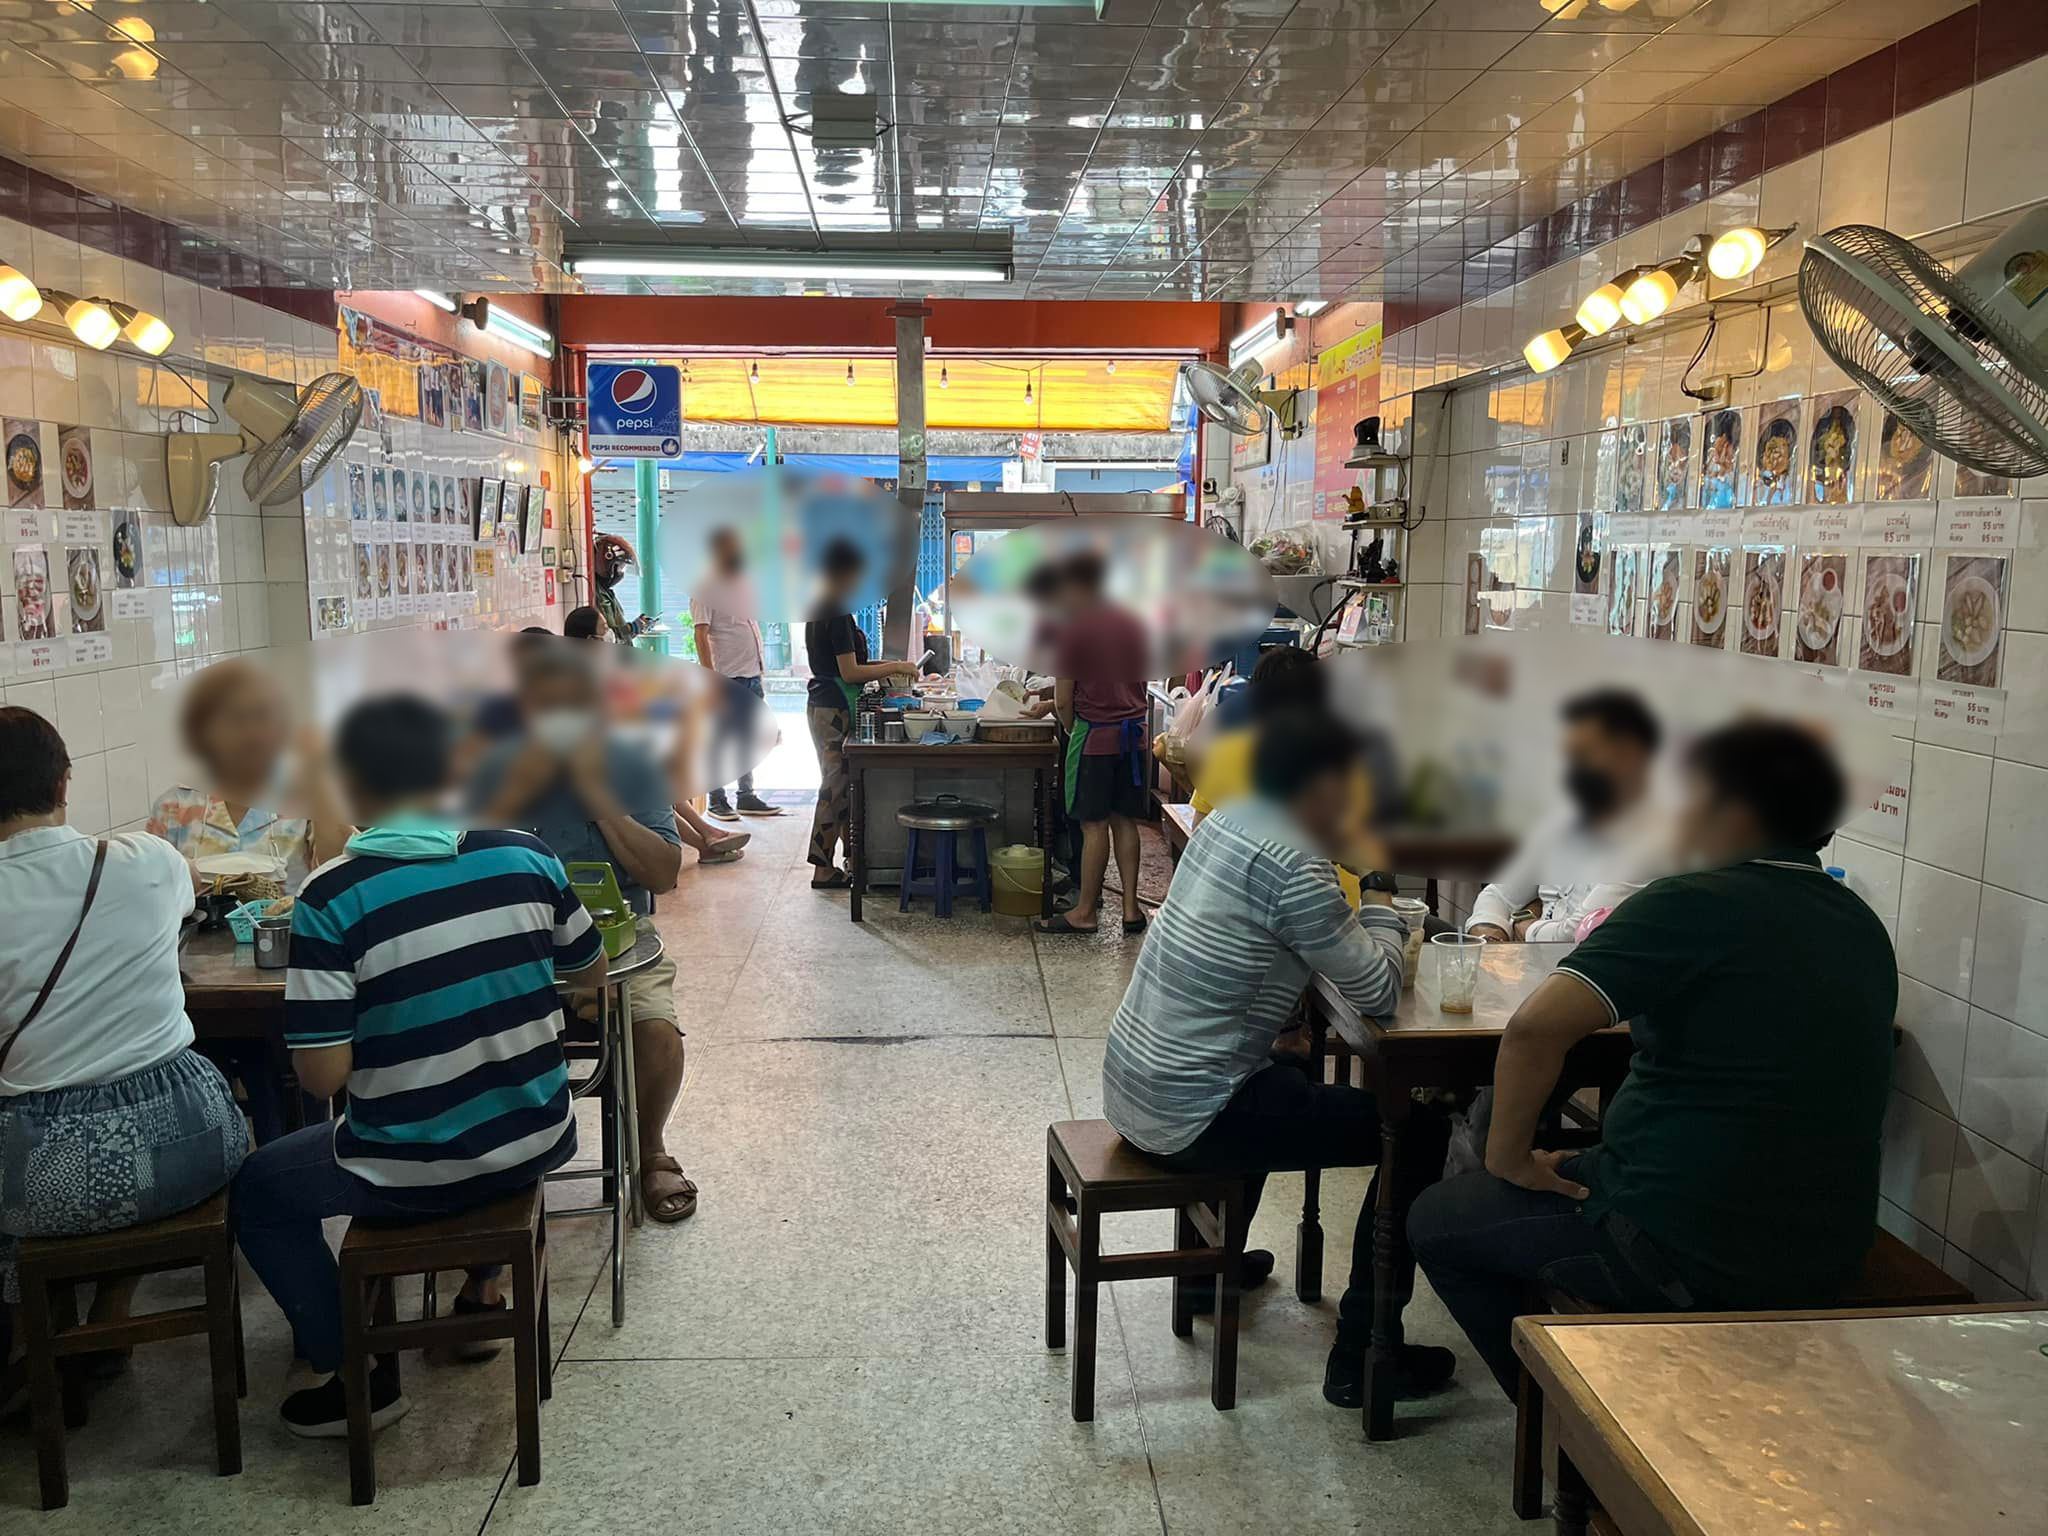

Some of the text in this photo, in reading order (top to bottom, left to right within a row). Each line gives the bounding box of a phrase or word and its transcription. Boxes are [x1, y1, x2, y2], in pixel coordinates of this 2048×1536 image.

[617, 417, 653, 430] pepsi
[611, 444, 660, 452] RECOMMENDED
[1983, 521, 1992, 530] 55
[1993, 522, 2005, 530] บาท
[1896, 533, 1911, 543] บาท
[1880, 699, 1894, 710] บาท
[1967, 702, 1977, 712] 55
[1978, 705, 1990, 714] บาท
[1976, 717, 1989, 727] บาท
[1882, 803, 1899, 817] บาท
